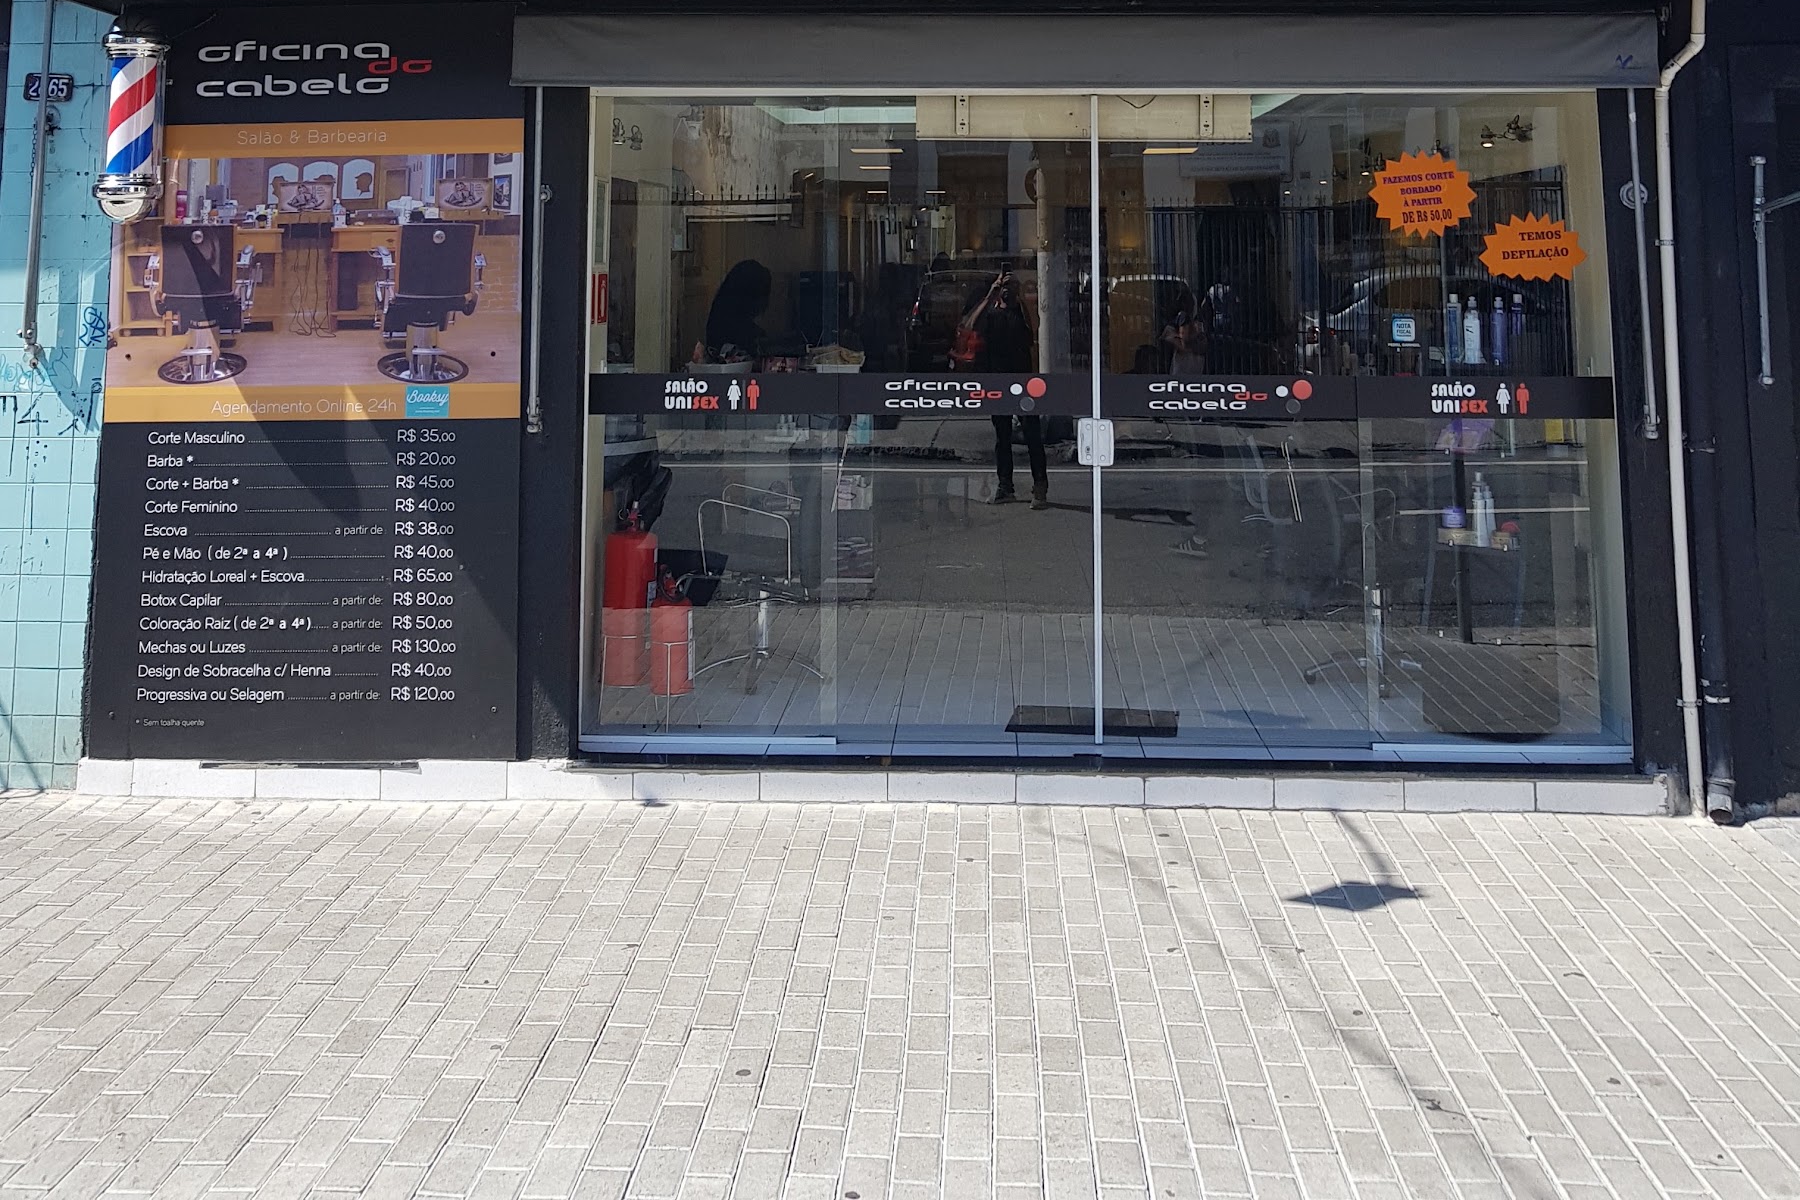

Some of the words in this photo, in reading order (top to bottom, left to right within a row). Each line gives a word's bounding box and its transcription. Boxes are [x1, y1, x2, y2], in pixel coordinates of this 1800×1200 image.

[198, 40, 390, 64] oficina
[368, 57, 432, 74] do
[29, 77, 68, 97] 265
[197, 74, 389, 98] cabelo
[237, 129, 282, 145] Salão
[290, 130, 300, 144] &
[307, 128, 387, 144] Barbearia
[1383, 173, 1423, 185] FAZEMOS
[1425, 171, 1455, 181] CORTE
[1400, 185, 1442, 195] BORDADO
[1411, 197, 1443, 207] PARTIR
[1402, 211, 1415, 224] DE
[1416, 210, 1428, 223] R$
[1430, 209, 1452, 222] 50,00
[1519, 230, 1561, 241] TEMOS
[1502, 246, 1569, 261] DEPILAÇÃO
[664, 378, 708, 394] SALÃO
[885, 379, 981, 392] oficina
[1149, 380, 1246, 393] oficina
[1431, 381, 1475, 397] SALÃO
[406, 389, 449, 406] Booksy
[970, 389, 1002, 399] do
[1235, 391, 1268, 401] do
[211, 400, 312, 416] Agendamento
[316, 398, 363, 413] Online
[368, 397, 397, 412] 24h
[664, 396, 719, 411] UNISEX
[885, 396, 981, 409] cabelo
[1149, 398, 1247, 411] cabelo
[1431, 399, 1489, 414] UNISEX
[148, 432, 181, 444] Corte
[185, 431, 245, 443] Masculino
[398, 429, 416, 442] R$
[420, 429, 455, 442] 35,00
[148, 455, 183, 466] Barba
[397, 452, 415, 465] R$
[419, 452, 455, 465] 20,00
[146, 478, 179, 490] Corte
[193, 477, 228, 489] Barba
[396, 475, 415, 489] R$
[419, 475, 454, 488] 45,00
[145, 501, 178, 513] Corte
[182, 501, 237, 512] Feminino
[396, 498, 414, 512] R$
[418, 499, 454, 512] 40,00
[145, 524, 187, 536] Escova
[344, 525, 368, 536] partir
[395, 521, 414, 535] R$
[418, 522, 453, 535] 38,00
[143, 547, 159, 559] Pé
[163, 550, 170, 559] e
[174, 547, 201, 559] Mão
[215, 547, 230, 559] de
[253, 550, 260, 559] a
[395, 545, 413, 559] R$
[417, 545, 453, 559] 40,00
[142, 570, 206, 584] Hidratação
[210, 570, 246, 582] Loreal
[261, 570, 304, 582] Escova
[394, 568, 413, 582] R$
[417, 569, 452, 582] 65,00
[141, 594, 176, 606] Botox
[180, 593, 222, 609] Capilar
[342, 596, 366, 607] partir
[394, 592, 412, 606] R$
[416, 592, 453, 606] 80,00
[140, 617, 201, 631] Coloração
[205, 617, 231, 629] Raiz
[241, 617, 256, 629] de
[279, 620, 286, 629] a
[341, 619, 365, 630] partir
[393, 615, 412, 629] R$
[416, 616, 452, 629] 50,00
[139, 641, 186, 653] Mechas
[190, 644, 205, 653] ou
[210, 641, 245, 653] Luzes
[341, 642, 365, 654] partir
[392, 639, 411, 653] R$
[415, 639, 456, 653] 130,00
[138, 665, 180, 680] Design
[185, 664, 199, 676] de
[203, 664, 270, 676] Sobracelha
[274, 664, 287, 676] c/
[291, 664, 330, 676] Henna
[392, 663, 411, 677] R$
[415, 663, 451, 677] 40,00
[137, 688, 206, 703] Progressiva
[211, 691, 226, 700] ou
[230, 688, 284, 703] Selagem
[330, 692, 335, 700] a
[339, 690, 363, 702] partir
[391, 686, 410, 701] R$
[414, 687, 454, 700] 120,00
[143, 718, 159, 726] Sem
